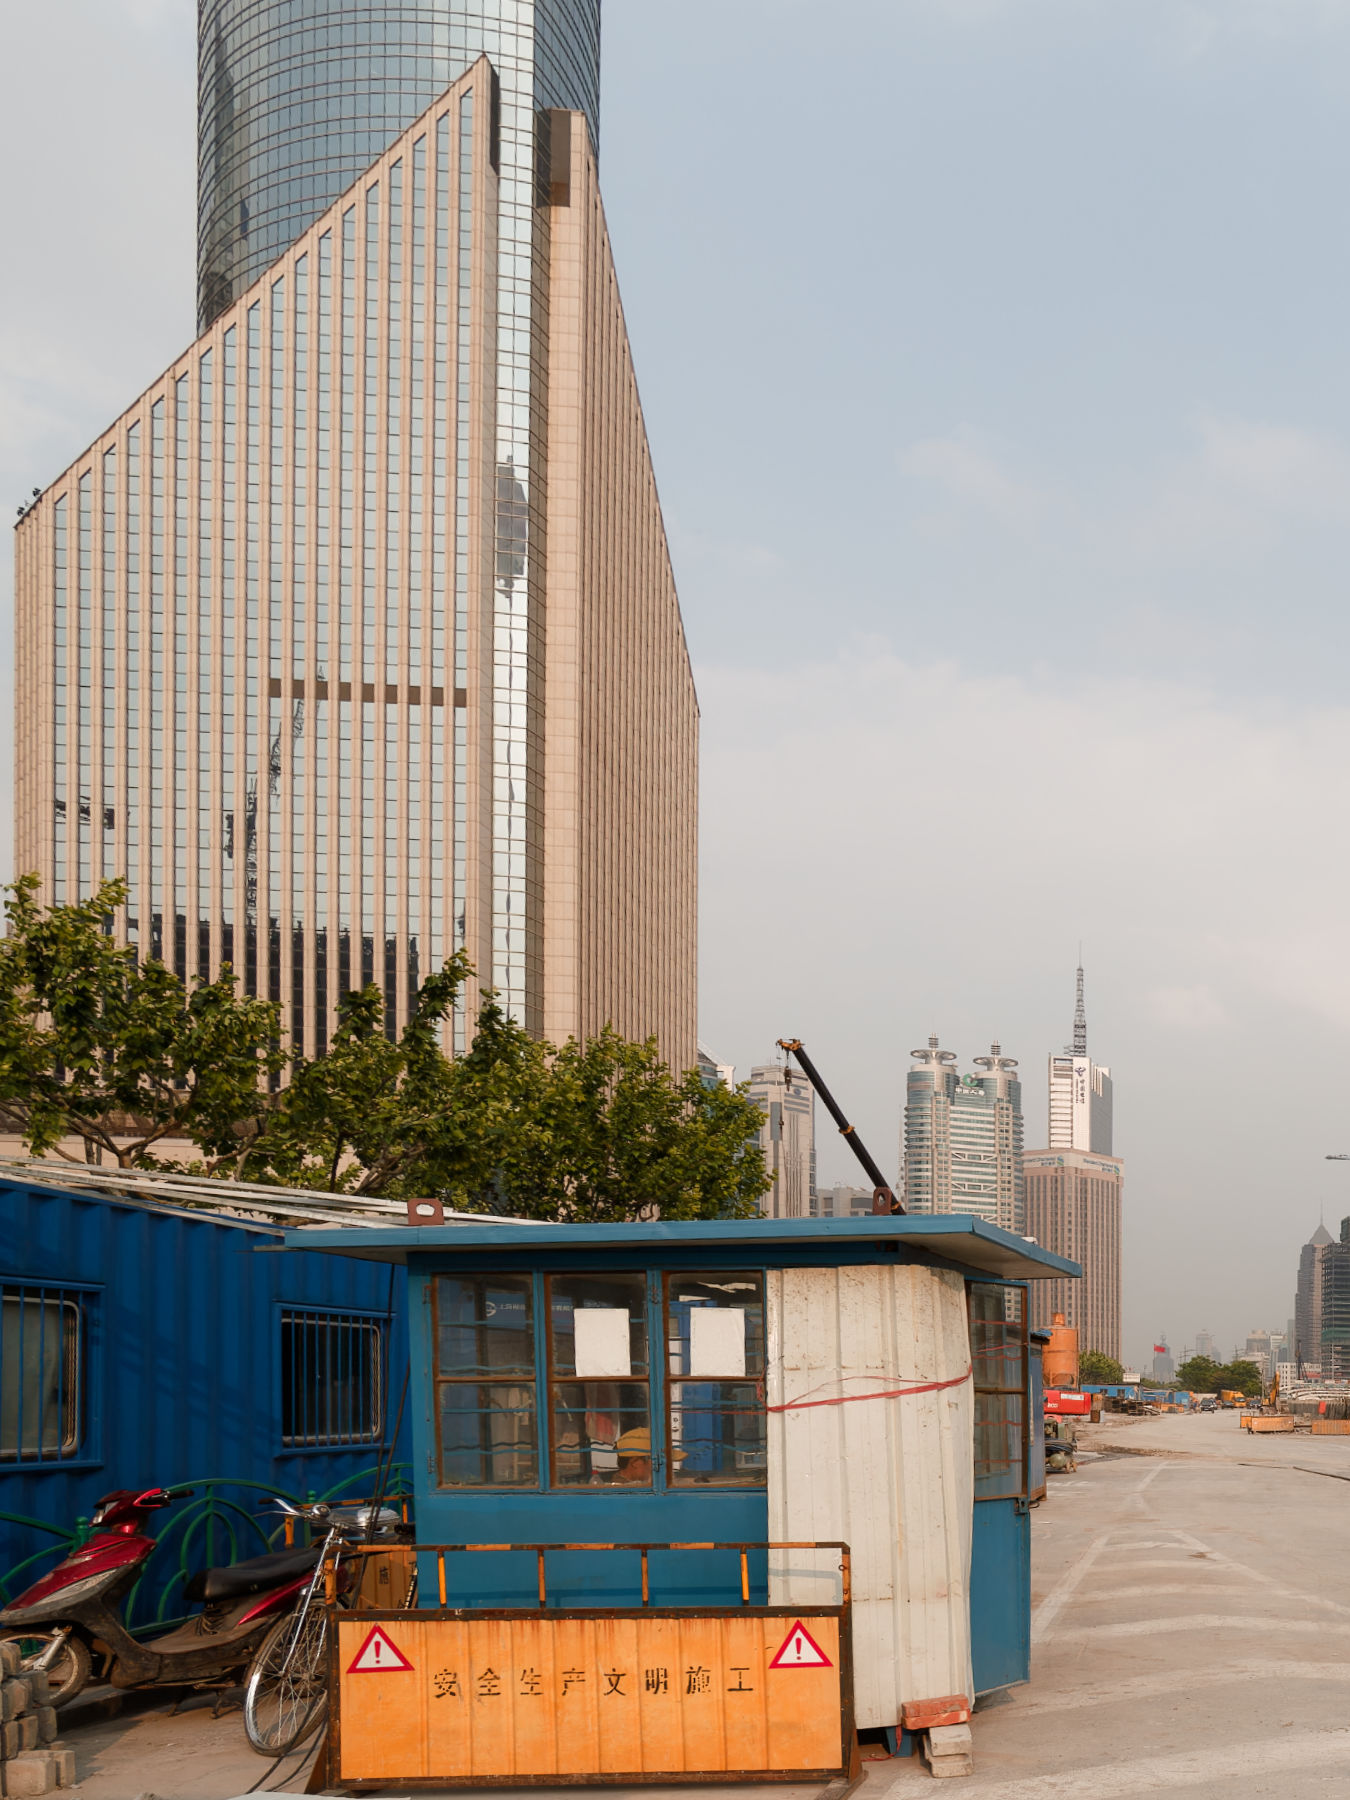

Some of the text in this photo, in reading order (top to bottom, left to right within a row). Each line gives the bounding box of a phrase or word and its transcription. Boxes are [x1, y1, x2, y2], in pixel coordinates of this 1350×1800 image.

[434, 1665, 755, 1698] 安全生产文明施工
